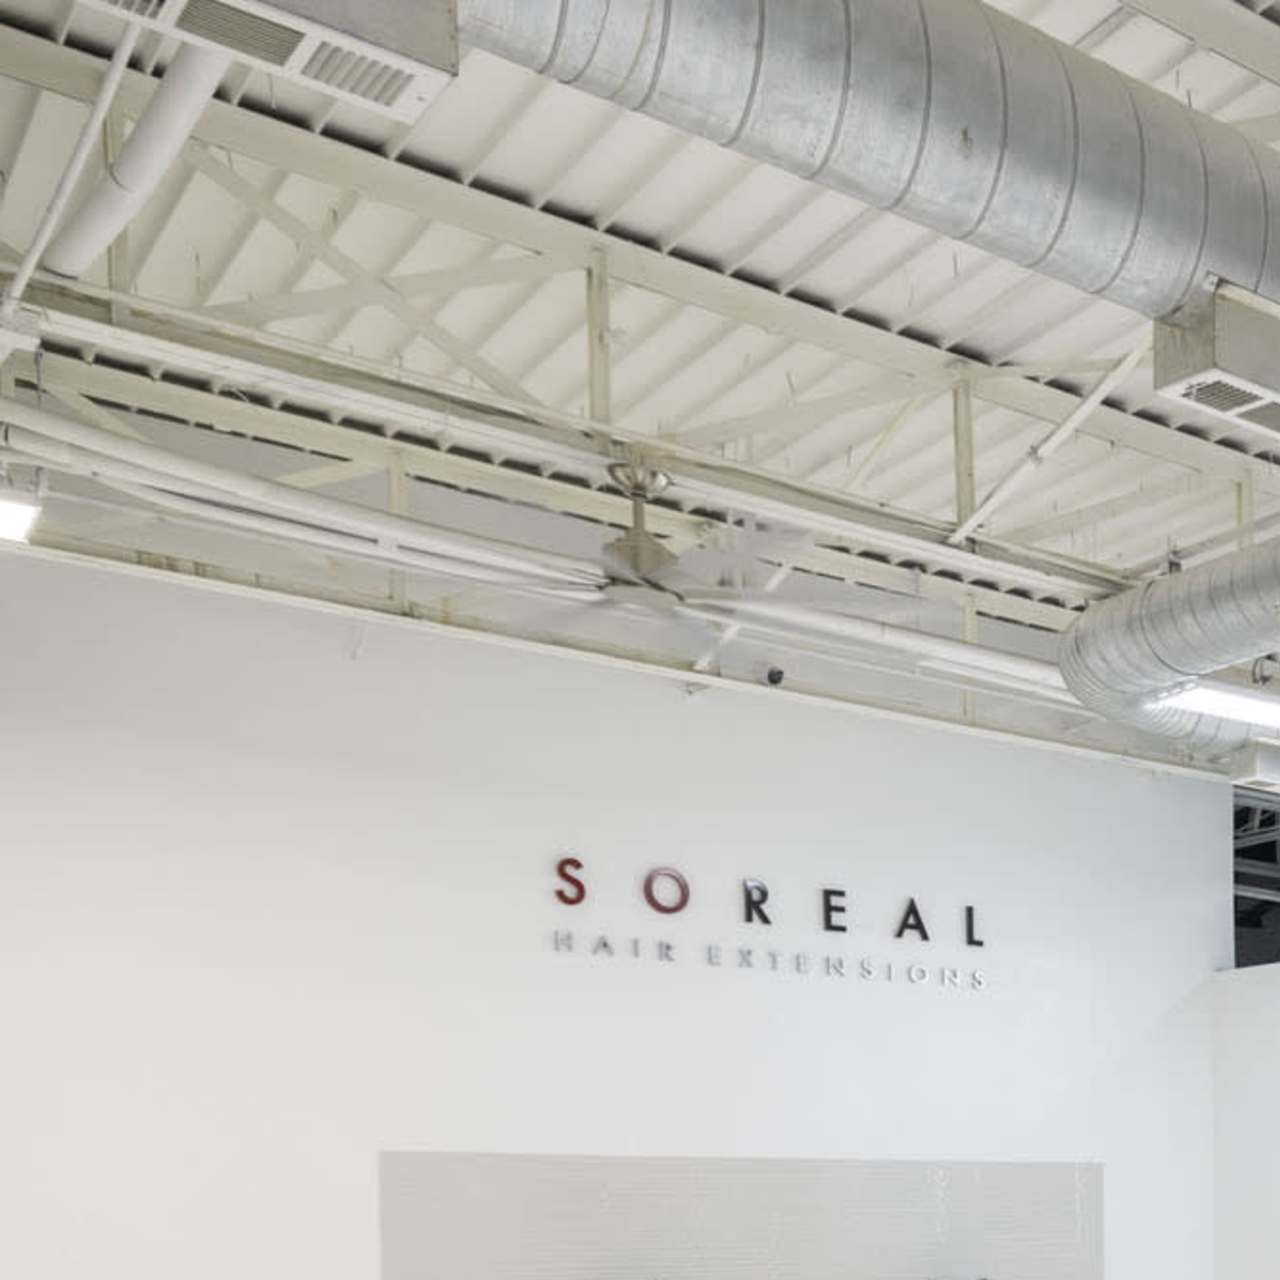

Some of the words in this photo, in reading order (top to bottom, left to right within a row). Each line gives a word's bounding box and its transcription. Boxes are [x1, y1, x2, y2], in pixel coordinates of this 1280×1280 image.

[554, 857, 985, 947] SOREAL
[553, 930, 675, 963] HAIR
[705, 944, 987, 989] EXTENSIONS
